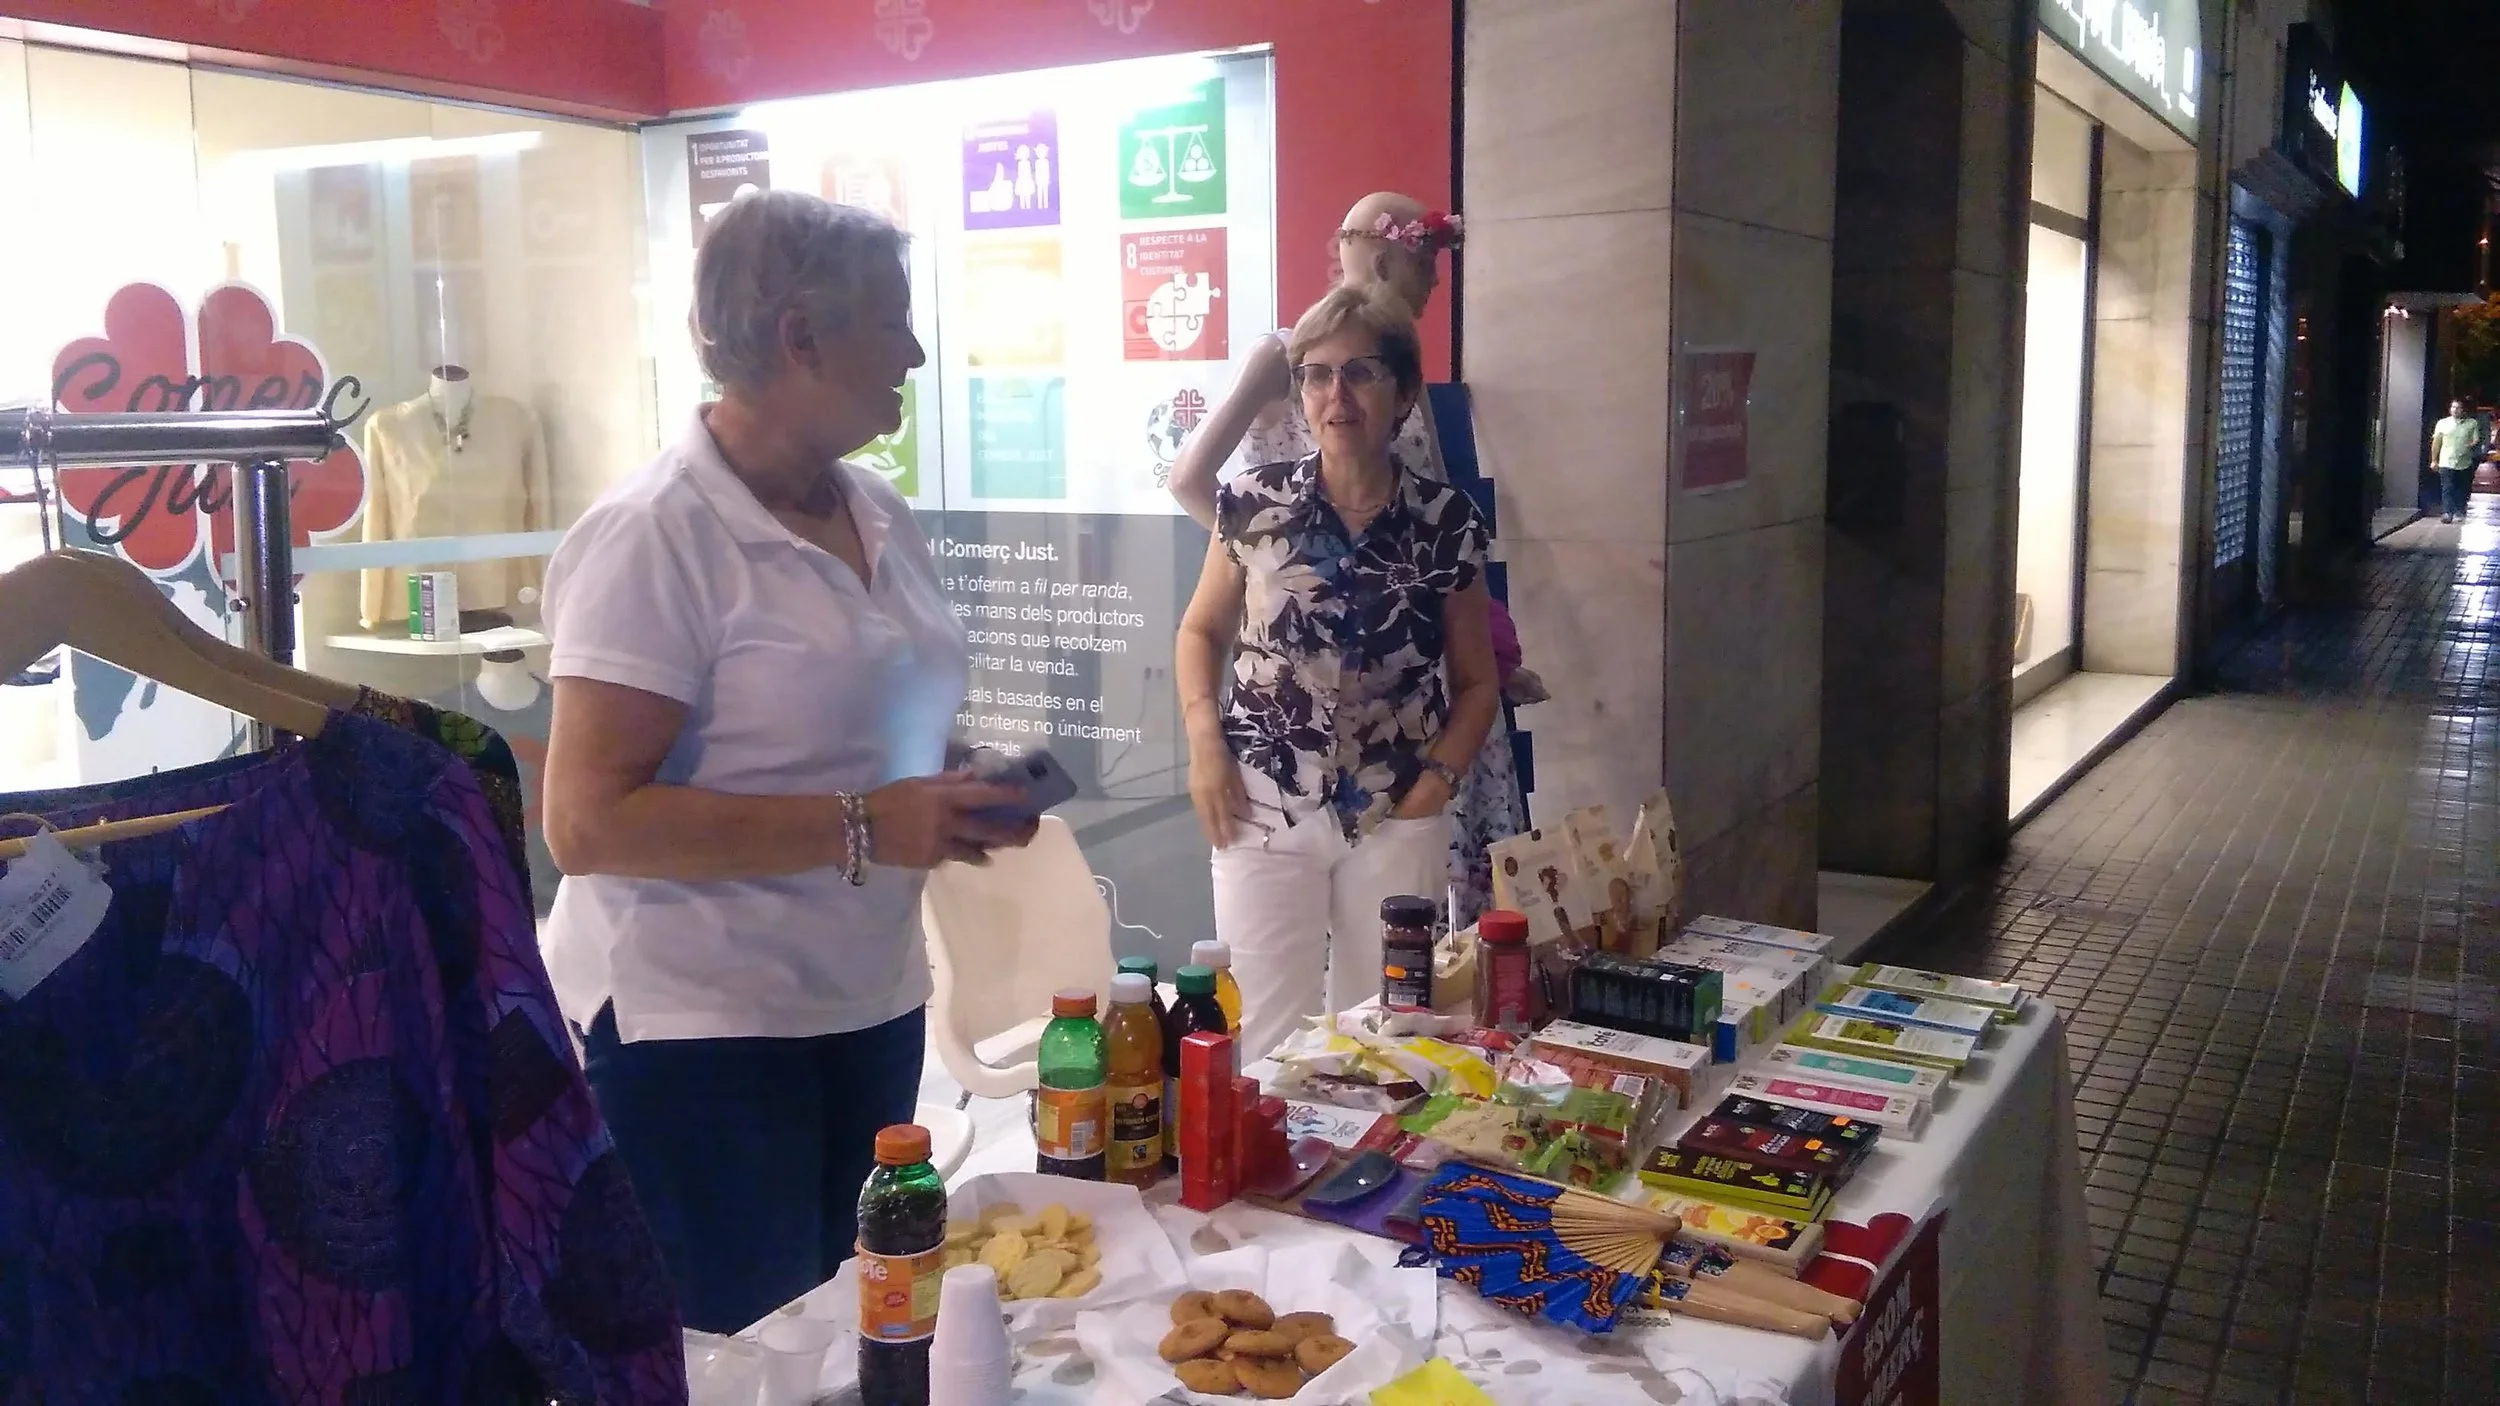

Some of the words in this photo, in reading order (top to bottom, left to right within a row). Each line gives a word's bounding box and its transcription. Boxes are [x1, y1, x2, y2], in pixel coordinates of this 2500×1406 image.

[1139, 234, 1186, 246] RESPECTE
[1195, 231, 1208, 244] LA
[1126, 242, 1137, 269] 8
[1139, 249, 1185, 261] IDENTITAT
[1139, 264, 1184, 277] CULTURAL
[940, 537, 1011, 565] Comerç
[1014, 541, 1059, 561] Just.
[959, 575, 1016, 593] t'oferim
[1020, 580, 1031, 594] a
[1034, 577, 1048, 595] fil
[1050, 581, 1079, 599] per
[1081, 581, 1132, 602] randa,
[976, 604, 1017, 620] mans
[1021, 604, 1053, 622] dels
[1057, 607, 1144, 628] productors
[967, 629, 1017, 646] acions
[1020, 633, 1051, 651] que
[1054, 634, 1127, 653] recolzem
[1010, 655, 1023, 673] la
[1027, 658, 1079, 677] venda.
[997, 687, 1062, 710] basades
[1066, 696, 1086, 712] en
[1090, 696, 1104, 713] el
[980, 713, 1030, 733] criteris
[1034, 720, 1054, 735] no
[1058, 718, 1142, 744] únicament
